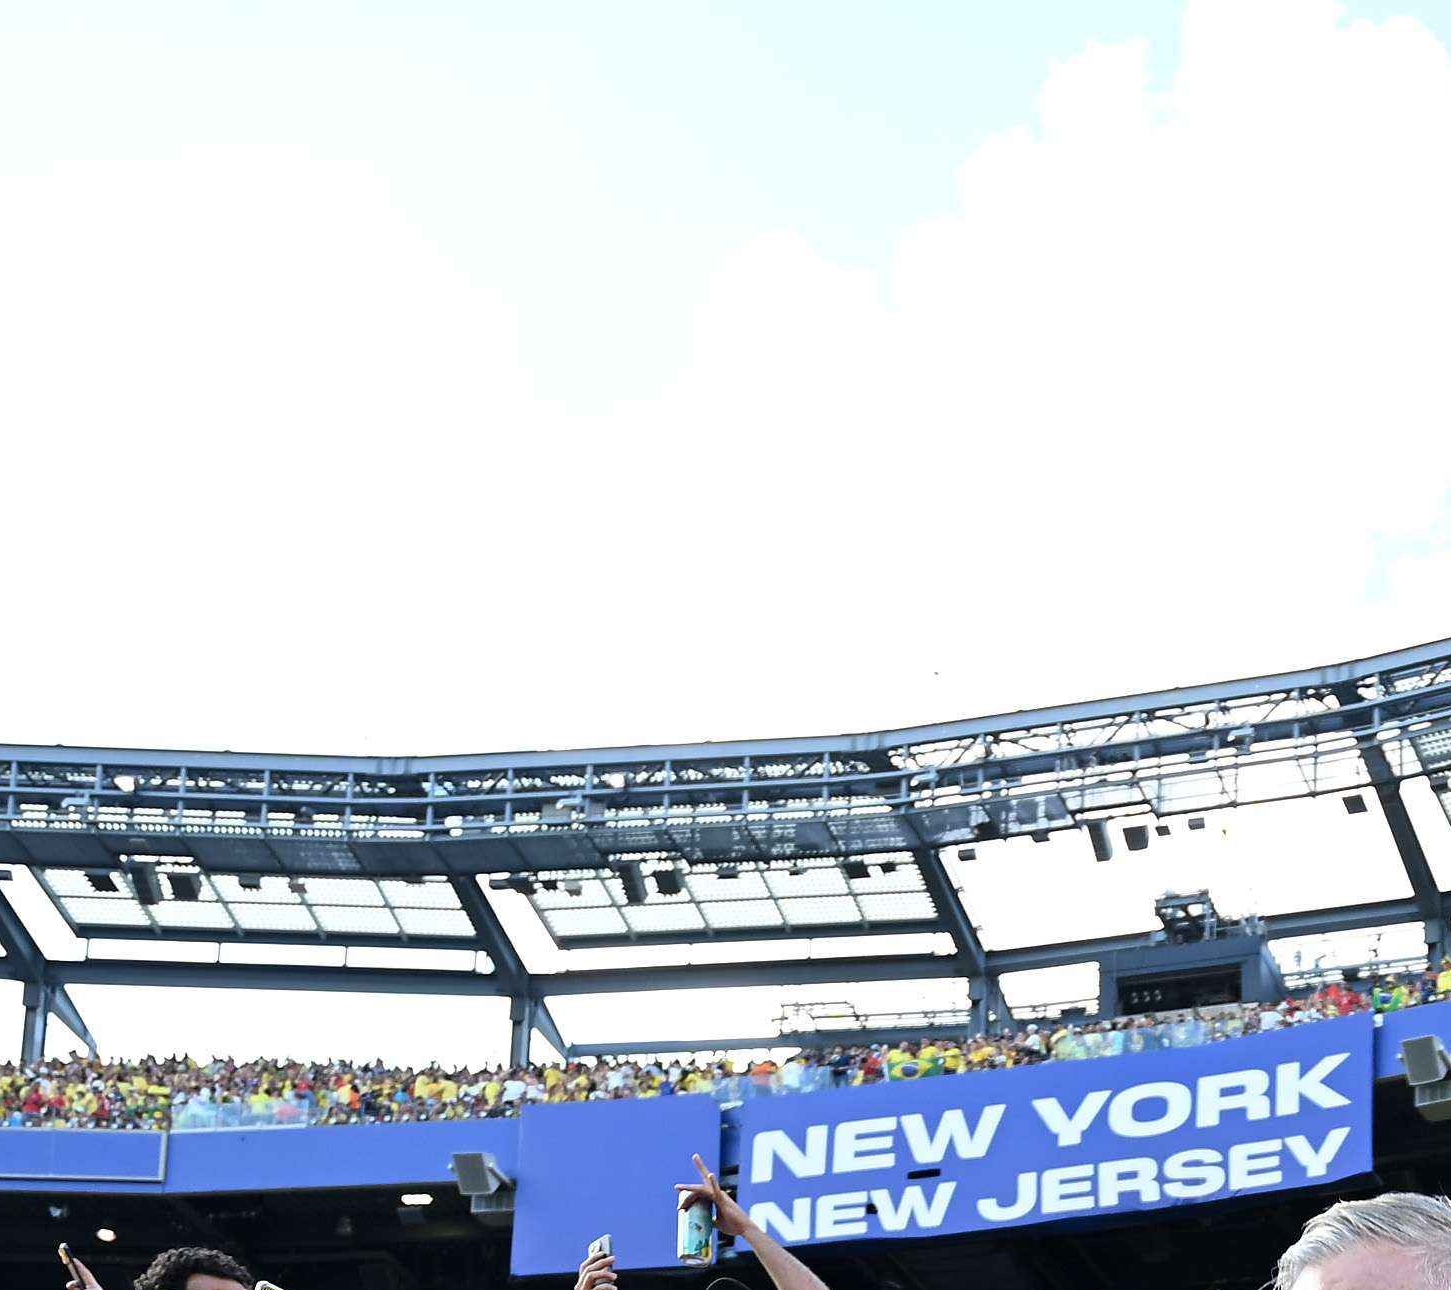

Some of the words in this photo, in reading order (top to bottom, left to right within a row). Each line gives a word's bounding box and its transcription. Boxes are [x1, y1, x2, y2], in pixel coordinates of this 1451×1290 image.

[750, 1103, 1007, 1185] NEW
[1032, 1052, 1353, 1147] YORK
[749, 1181, 957, 1244] NEW
[976, 1126, 1352, 1222] JERSEY
